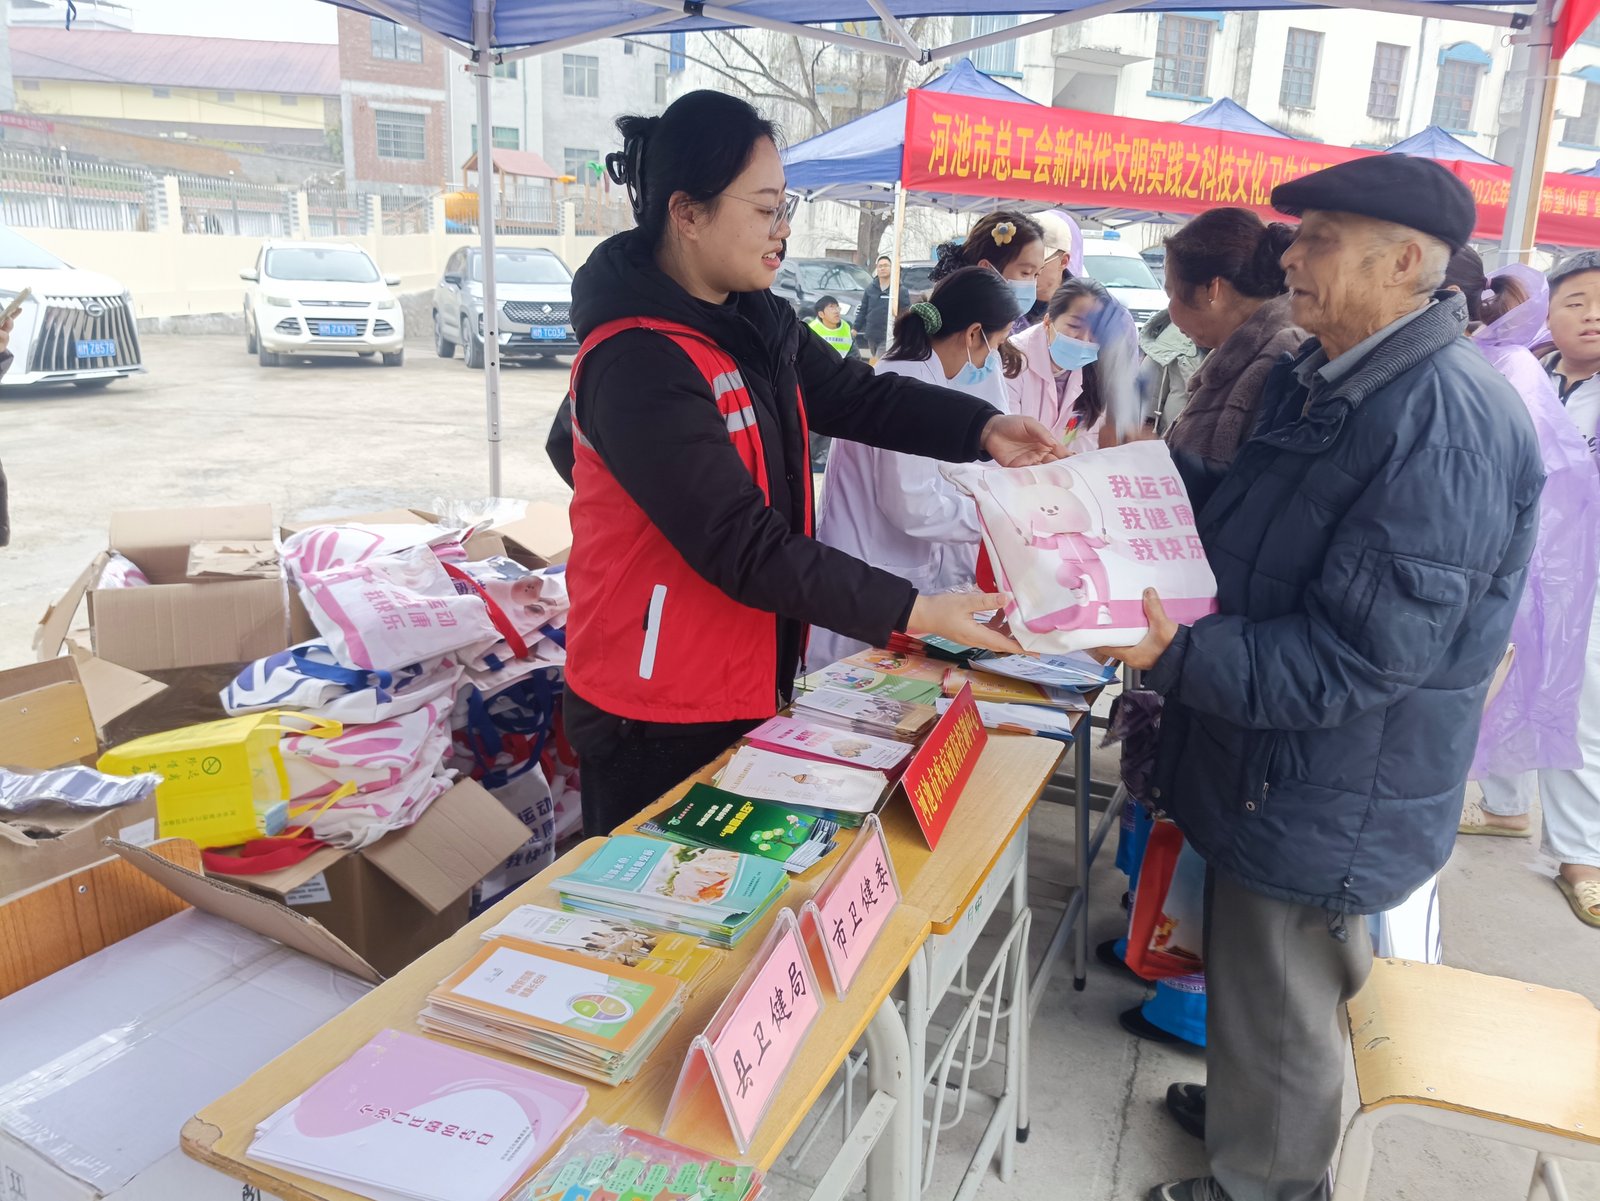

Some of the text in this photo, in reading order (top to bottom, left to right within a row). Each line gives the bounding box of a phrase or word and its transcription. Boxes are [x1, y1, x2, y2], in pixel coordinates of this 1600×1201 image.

[1107, 475, 1184, 499] 我运动
[1117, 504, 1195, 530] 我健康
[1128, 534, 1207, 561] 我快乐
[832, 857, 890, 960] 市卫健委
[732, 961, 807, 1100] 县卫健局
